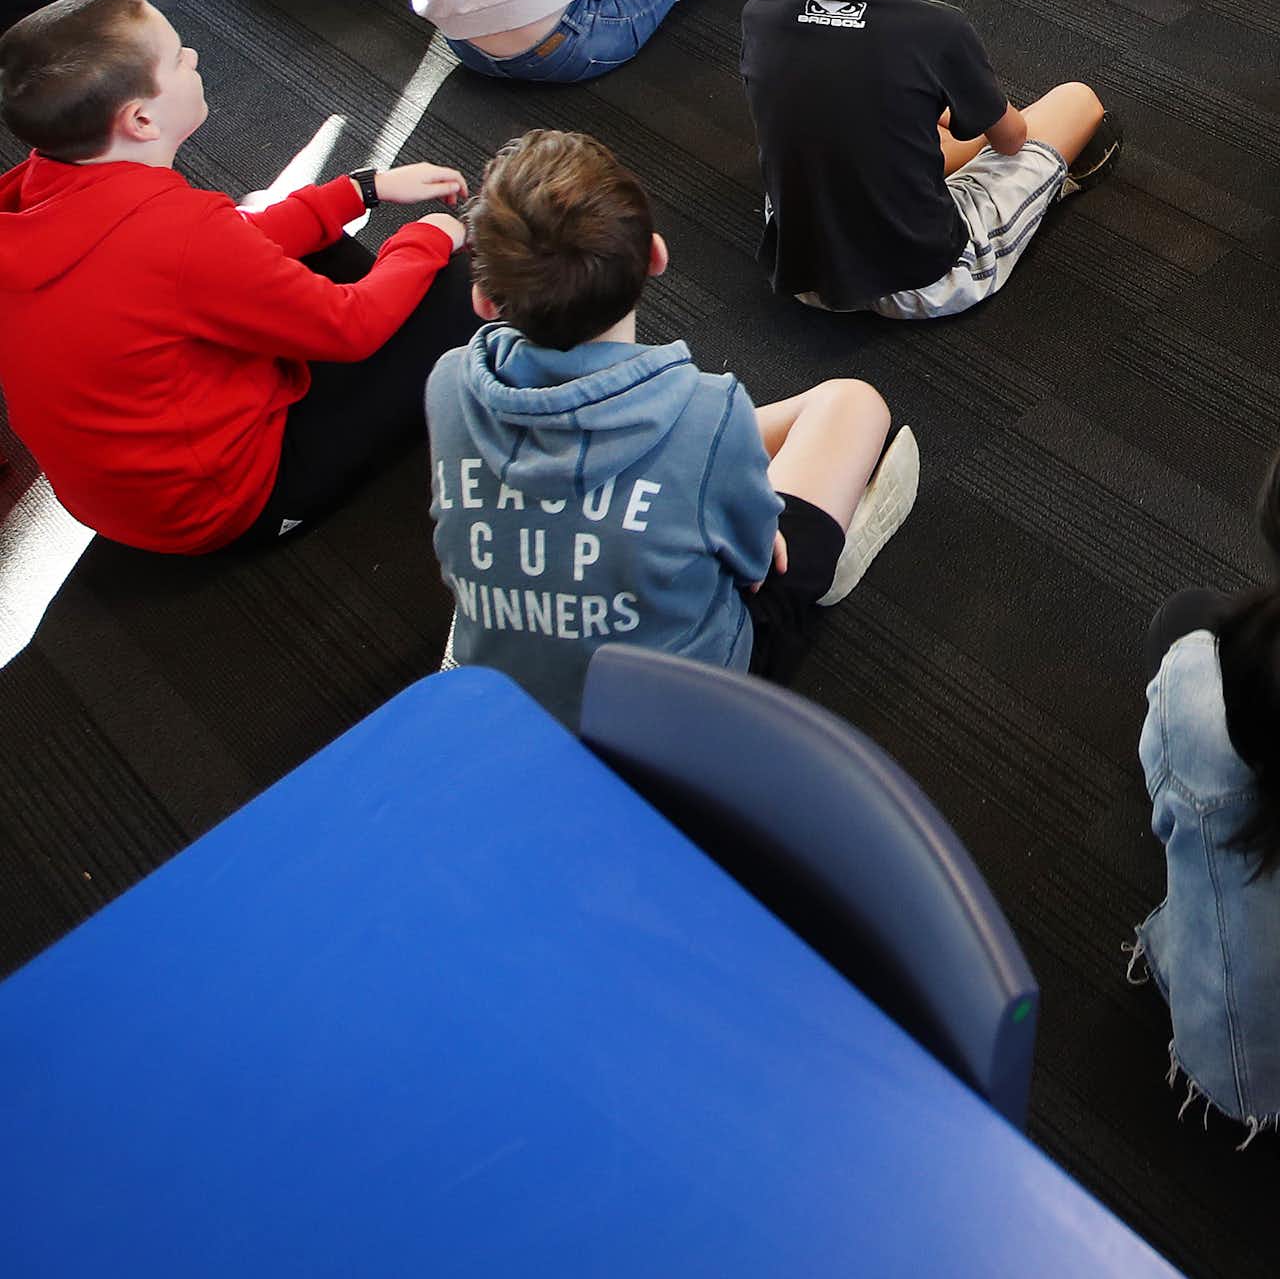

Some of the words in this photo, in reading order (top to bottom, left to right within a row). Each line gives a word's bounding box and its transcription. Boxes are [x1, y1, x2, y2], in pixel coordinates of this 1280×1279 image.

[436, 457, 662, 533] LEAUE
[469, 520, 601, 582] CUP
[451, 573, 641, 641] WINNERS
